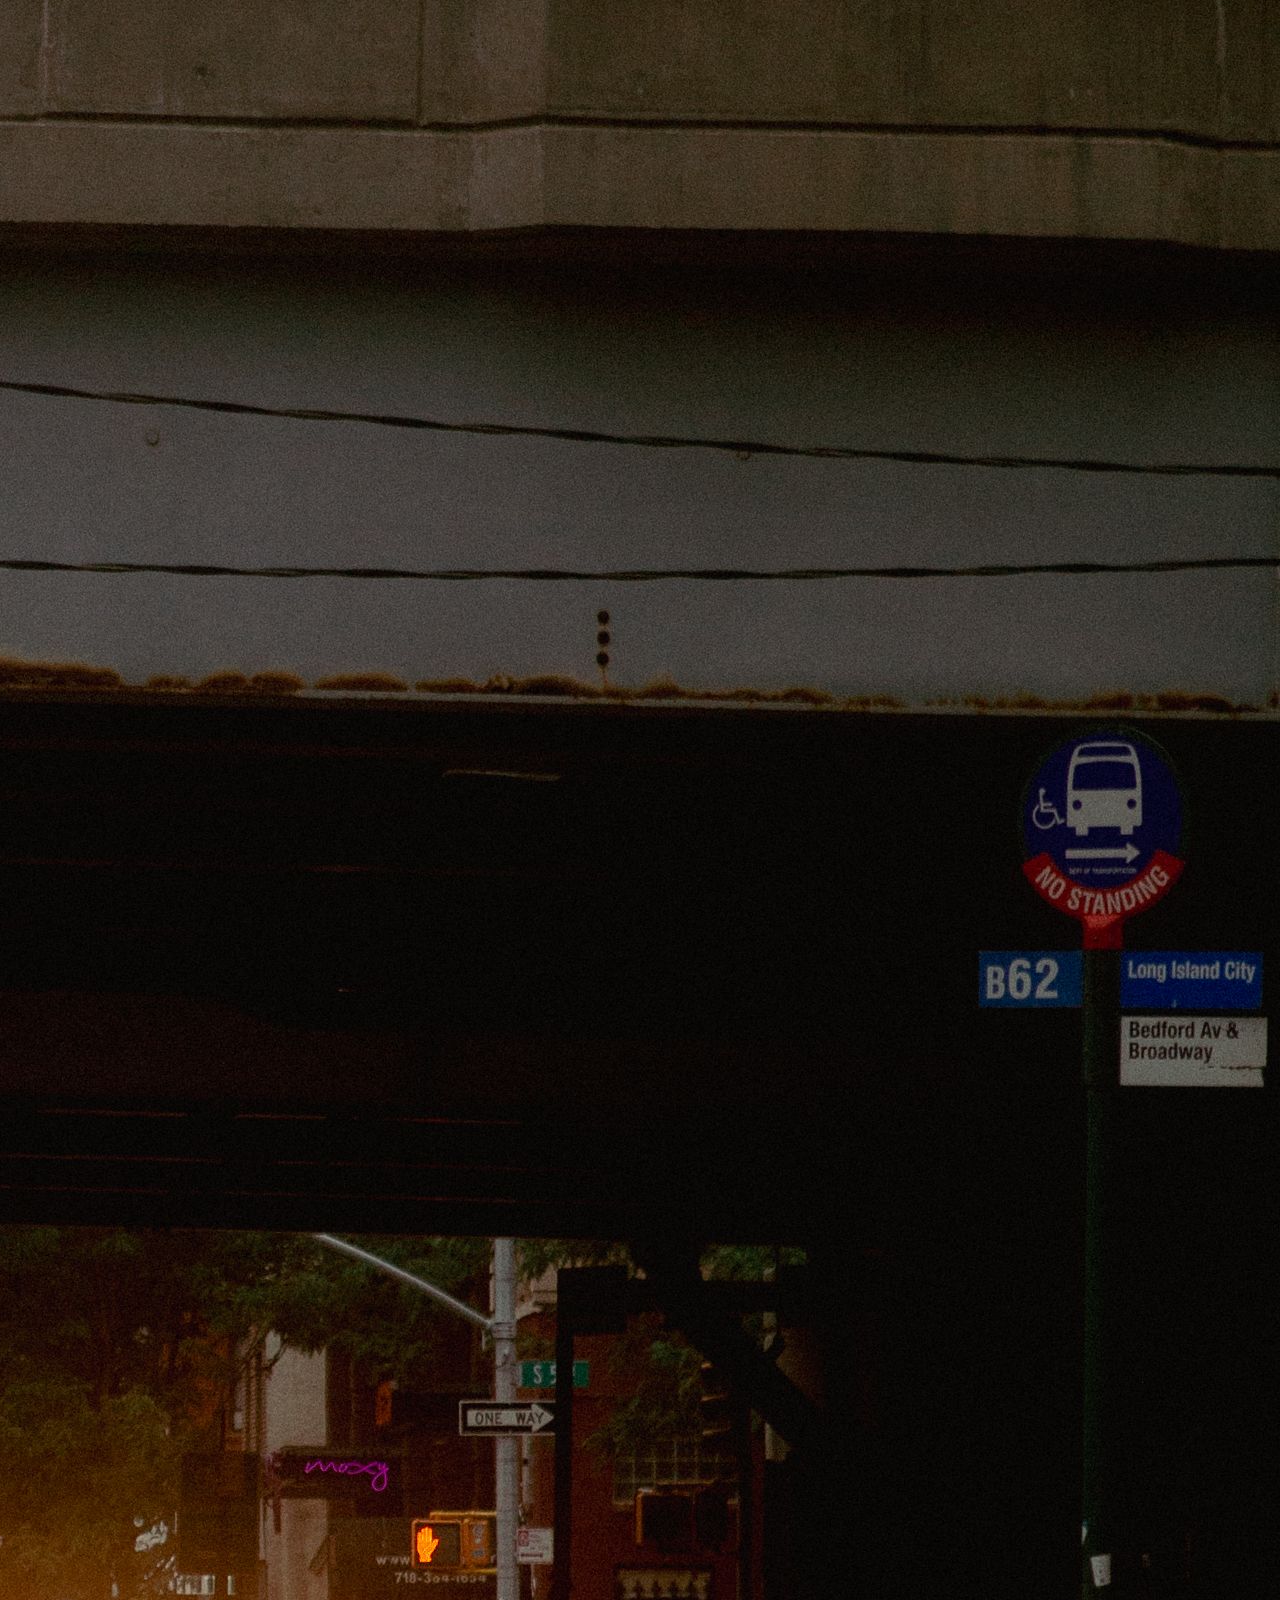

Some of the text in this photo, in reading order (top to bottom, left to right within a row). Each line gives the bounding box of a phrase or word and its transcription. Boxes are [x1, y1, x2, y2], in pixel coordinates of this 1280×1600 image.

[1035, 865, 1171, 915] NO STANDING
[985, 958, 1059, 1000] B62
[1128, 960, 1256, 984] Long Island City
[1129, 1020, 1239, 1039] Bedford Av &
[1128, 1042, 1213, 1063] Broadway
[533, 1364, 543, 1384] S
[475, 1412, 544, 1425] ONE WAY
